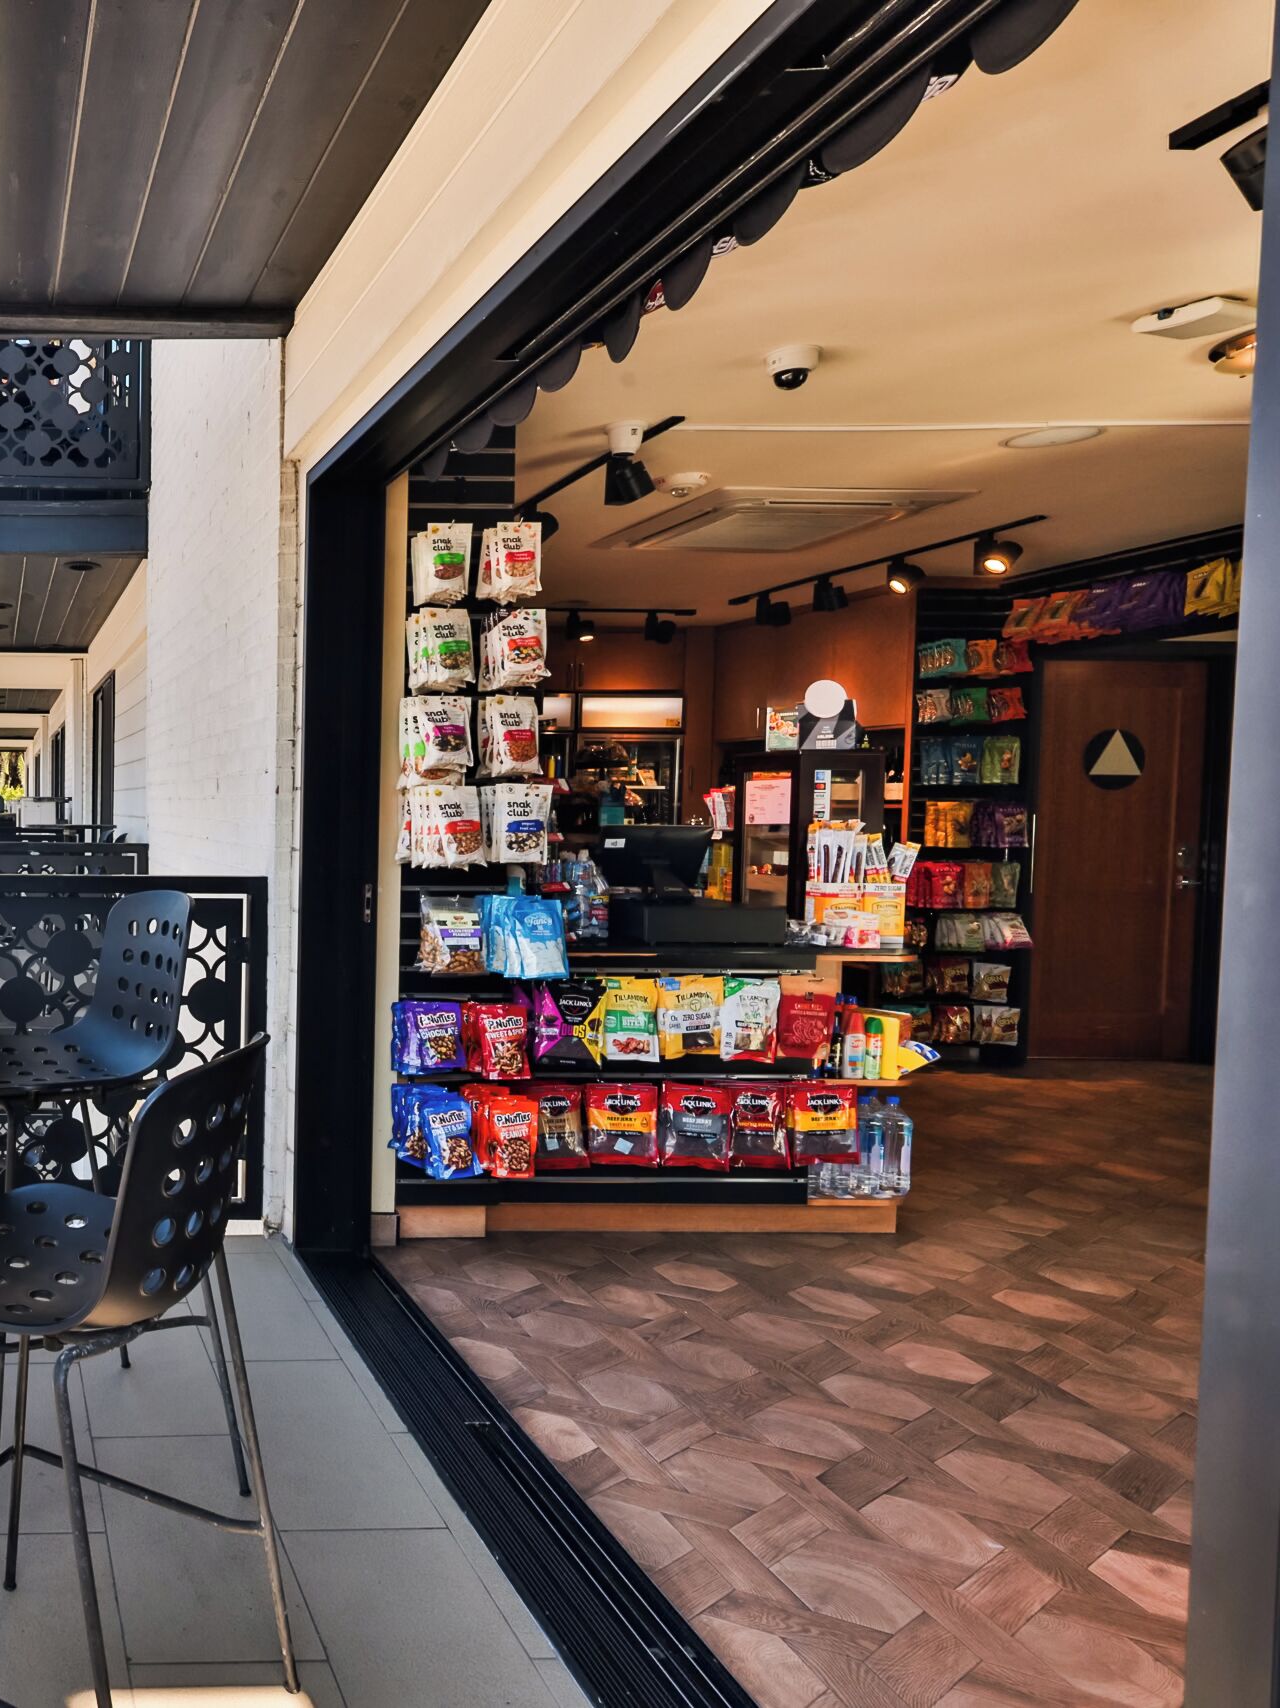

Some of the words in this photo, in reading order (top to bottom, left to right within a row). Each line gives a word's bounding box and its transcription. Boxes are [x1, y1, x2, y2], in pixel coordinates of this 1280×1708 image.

[432, 537, 452, 545] snak
[433, 623, 455, 631] snak
[435, 630, 455, 638] club
[425, 709, 448, 717] snak
[427, 715, 449, 723] club
[501, 719, 521, 727] club
[439, 802, 462, 810] snak
[507, 800, 531, 808] snak
[441, 809, 462, 818] club
[507, 808, 530, 817] club
[614, 994, 649, 1004] TILLAMOOK
[683, 1013, 695, 1021] ZERO
[420, 1027, 459, 1040] CHOCOLATE
[561, 1023, 586, 1038] DUOS
[604, 1098, 620, 1106] JACK
[680, 1099, 696, 1109] JACK
